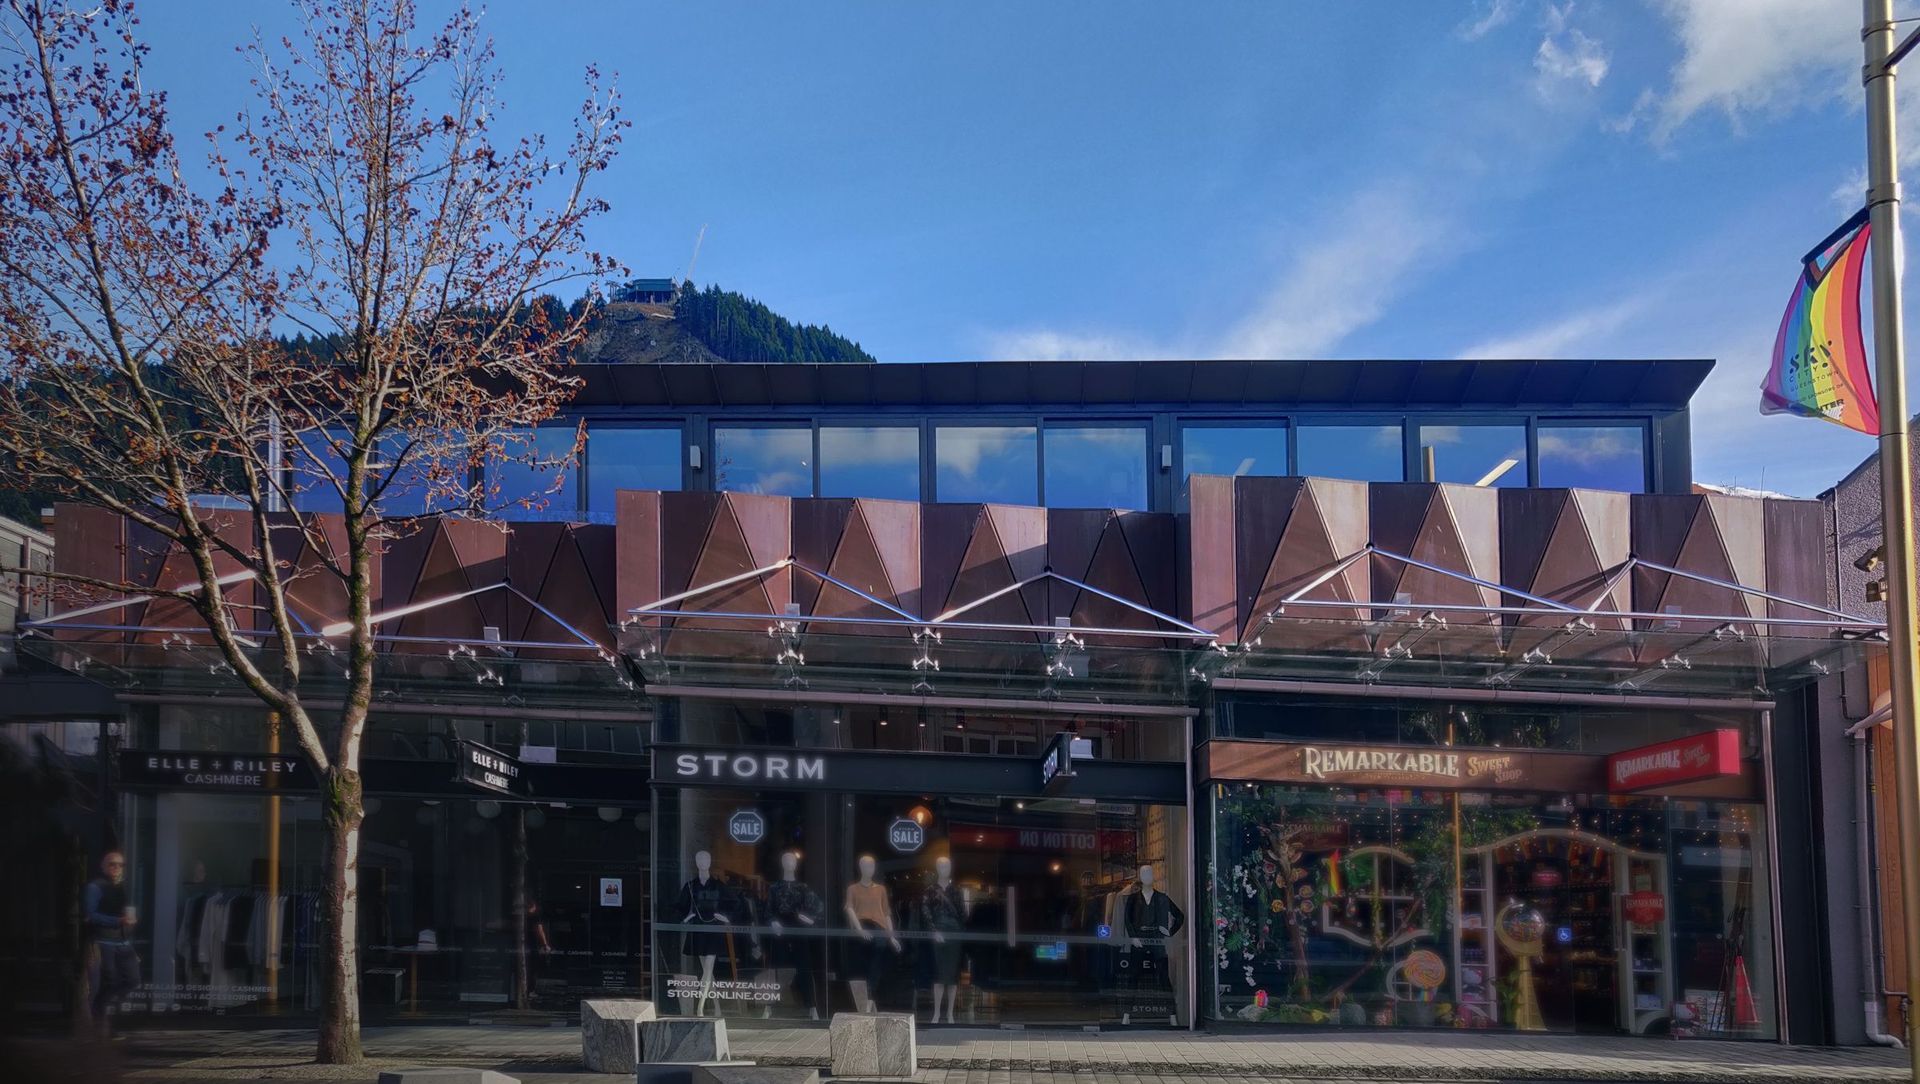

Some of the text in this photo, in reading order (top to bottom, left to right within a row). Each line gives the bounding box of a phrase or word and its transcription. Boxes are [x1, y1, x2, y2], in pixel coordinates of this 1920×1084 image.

[1789, 365, 1818, 383] CITY
[148, 757, 297, 773] ELLE + RILEY
[472, 751, 491, 768] ELLE
[499, 761, 519, 778] RILEY
[676, 754, 824, 780] STORM
[1304, 747, 1459, 779] REMARKABLE
[1615, 749, 1681, 784] REMARKABLE
[184, 773, 263, 786] CASHMERE
[733, 822, 760, 835] SALE
[893, 831, 920, 843] SALE
[667, 980, 710, 988] PROUDLY
[736, 982, 781, 990] ZEALAND
[667, 989, 781, 1001] STORMONLINE.COM
[1132, 1005, 1167, 1013] STORM
